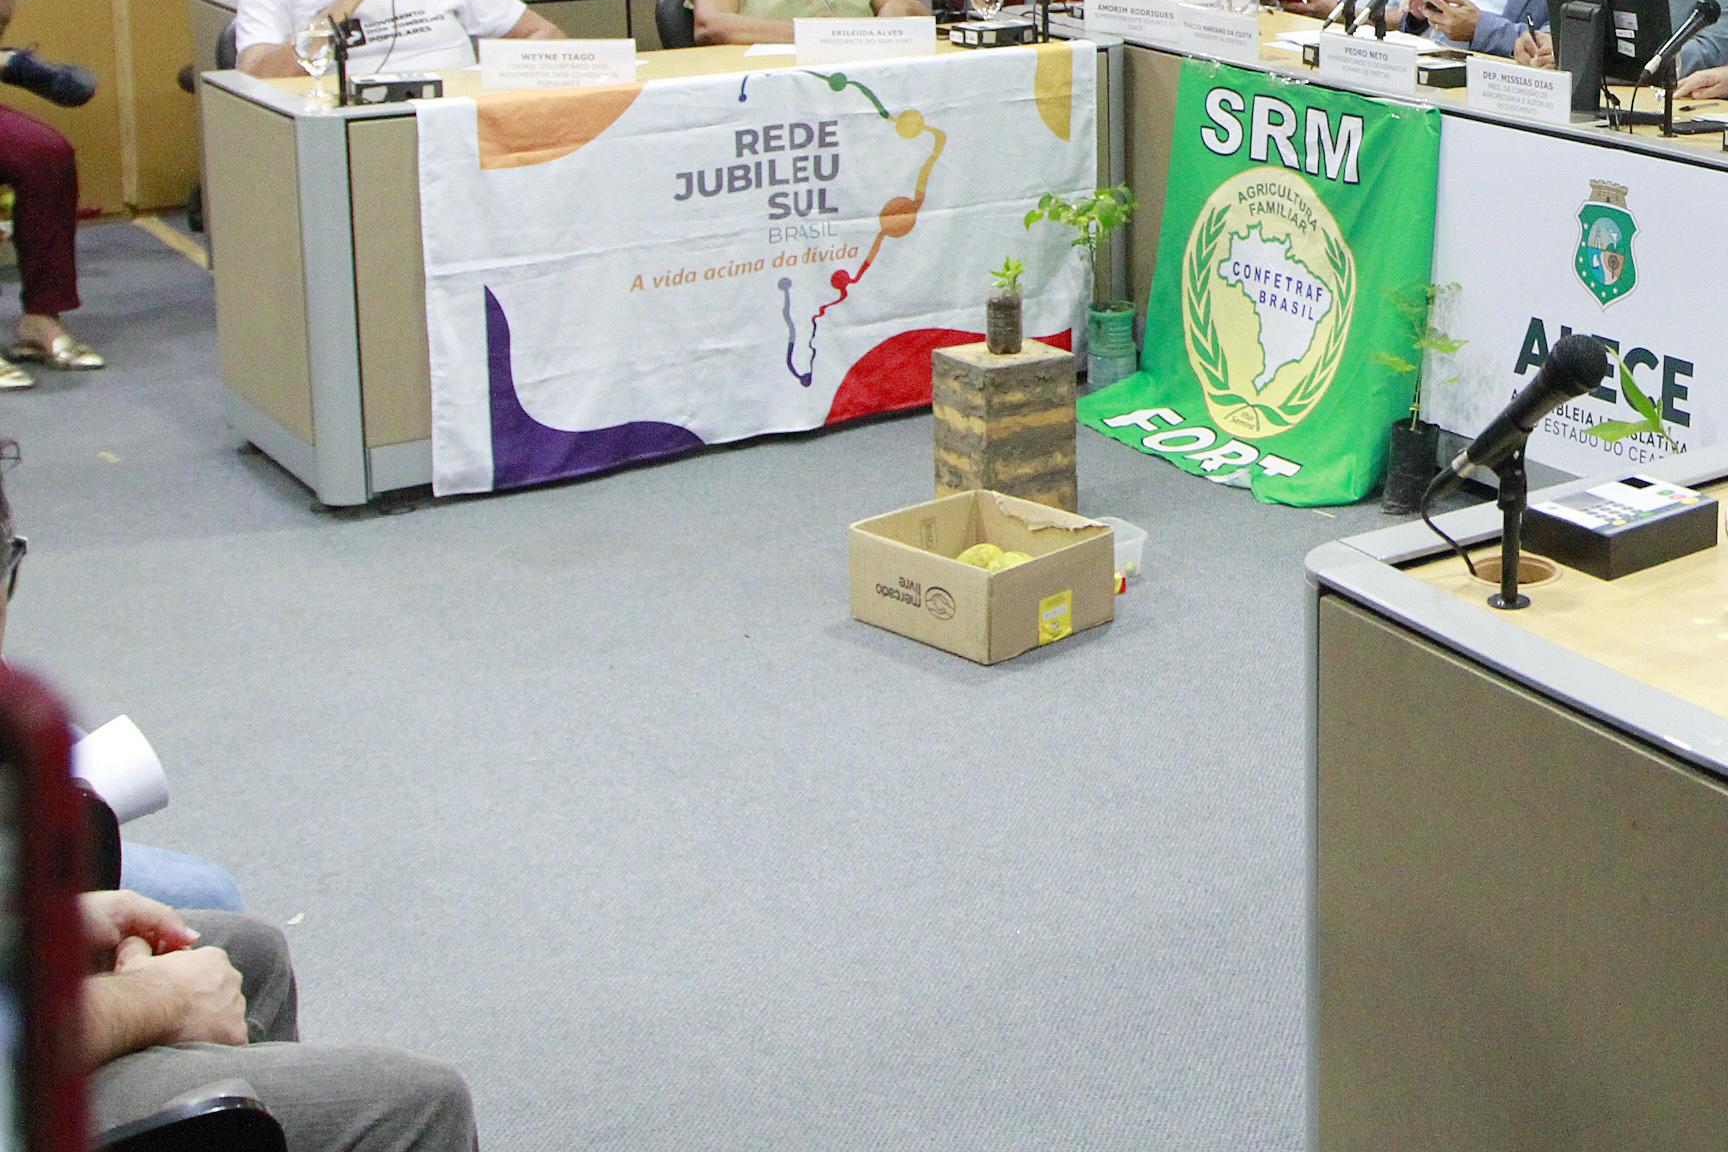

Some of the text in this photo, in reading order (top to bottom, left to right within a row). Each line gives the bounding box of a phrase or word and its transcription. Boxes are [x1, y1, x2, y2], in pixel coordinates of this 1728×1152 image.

[1097, 3, 1174, 20] AMORIM RODRIGUES
[368, 26, 431, 43] POPULARES
[831, 29, 874, 37] ERILEUDA
[521, 53, 595, 61] WEYNE TIAGO
[1344, 47, 1388, 61] PEDRO NETO
[1483, 71, 1554, 90] DEP. MISSIAS DIAS
[735, 120, 839, 158] REDE
[1201, 86, 1365, 185] SRM
[673, 154, 839, 202] JUBILEU
[768, 188, 838, 220] SUL
[1237, 182, 1318, 232] AGRICULTURA
[1249, 201, 1308, 235] FAMILIAR
[769, 220, 838, 244] BRASIL
[630, 242, 859, 292] A vida acima da dívida
[1232, 261, 1324, 303] CONFETRAF
[1259, 290, 1315, 322] BRASIL
[1513, 316, 1694, 429] AECE
[1101, 407, 1304, 479] FORT
[1544, 418, 1599, 449] ESTADO
[1604, 441, 1623, 456] DO
[876, 583, 921, 608] mercado
[899, 576, 921, 595] livre
